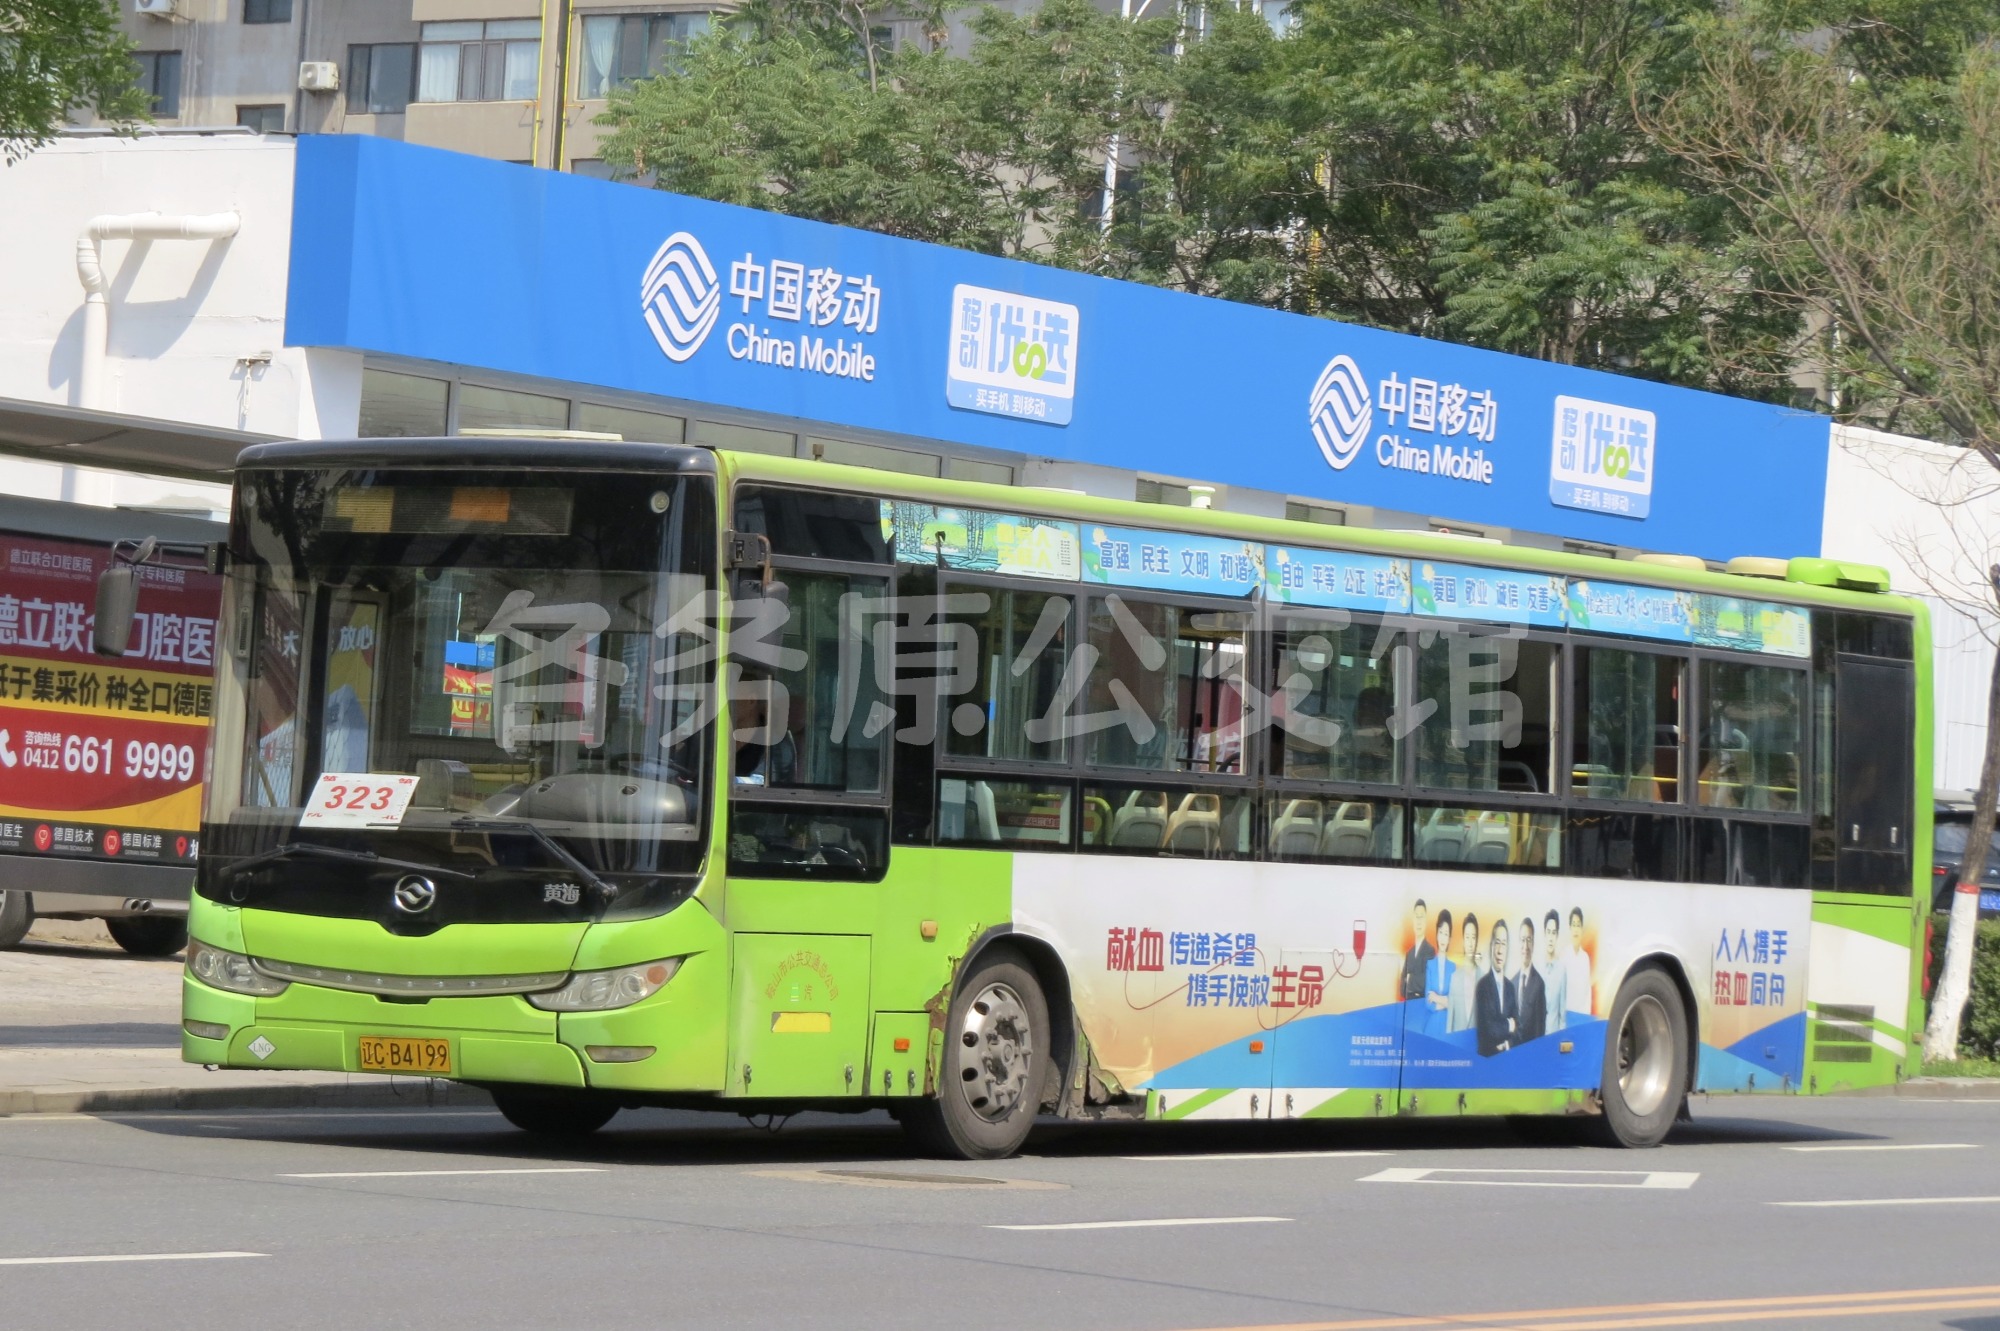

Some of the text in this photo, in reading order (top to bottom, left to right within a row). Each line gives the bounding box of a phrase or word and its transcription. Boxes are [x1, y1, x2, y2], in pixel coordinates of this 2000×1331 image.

[730, 252, 881, 334] 中国移动
[726, 322, 876, 382] China Mobile
[959, 297, 982, 370] 移动
[976, 388, 1046, 418] 买手机 到移动
[1378, 371, 1497, 443] 中国移动
[1560, 407, 1578, 471] 移动
[1376, 433, 1494, 485] China Mobile
[1100, 541, 1130, 570] 富强
[1142, 545, 1170, 573] 民主
[1181, 549, 1209, 578] 文明
[1220, 553, 1249, 582] 和谐
[1281, 562, 1304, 588] 自由
[1312, 564, 1335, 593] 平等
[1344, 567, 1366, 595] 公正
[1433, 577, 1456, 602] 爱国
[1496, 582, 1519, 608] 诚信
[1527, 585, 1549, 611] 友善
[25, 730, 61, 748] 咨询热线
[24, 735, 195, 783] 0412 661 9999
[324, 785, 394, 811] 323
[53, 826, 95, 845] 德国技术
[122, 832, 163, 849] 德国标准
[1106, 926, 1256, 972] 献血 传递希望
[1715, 927, 1788, 965] 人人携手
[1270, 964, 1324, 1009] 生命
[1714, 970, 1785, 1007] 热血同舟
[253, 1042, 271, 1054] LNG
